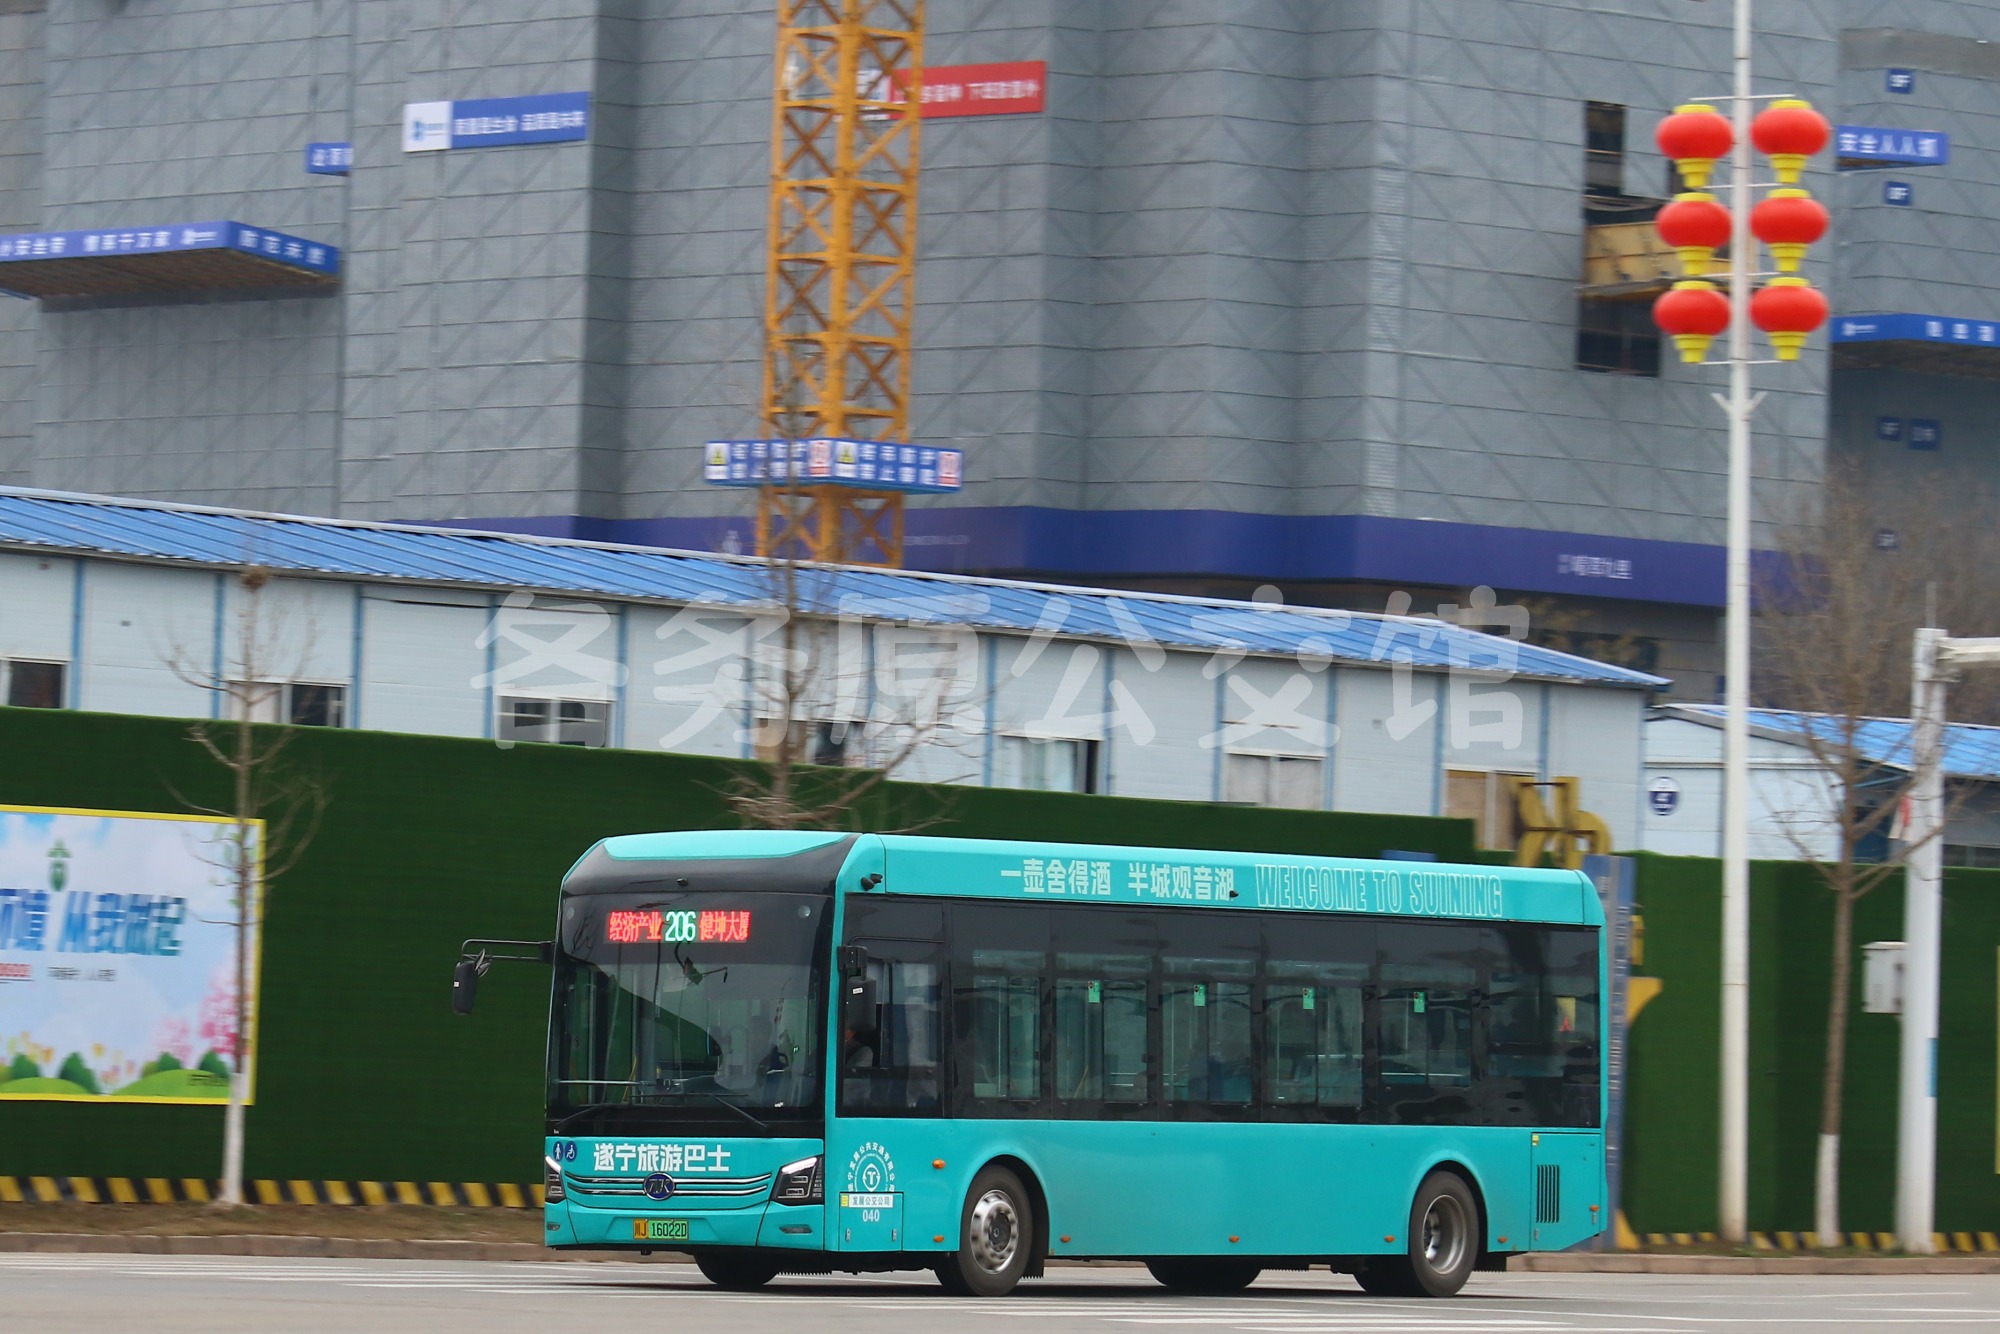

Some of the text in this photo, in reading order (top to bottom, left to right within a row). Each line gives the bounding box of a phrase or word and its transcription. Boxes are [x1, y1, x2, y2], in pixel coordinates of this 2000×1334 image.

[1000, 858, 1235, 902] 一壶舍得酒 半城观音湖
[1255, 864, 1503, 917] WELCOME TO SUINING
[608, 910, 662, 941] 经济产业
[665, 911, 697, 941] 206
[593, 1143, 732, 1172] 遂宁旅游巴士
[862, 1209, 880, 1222] 040
